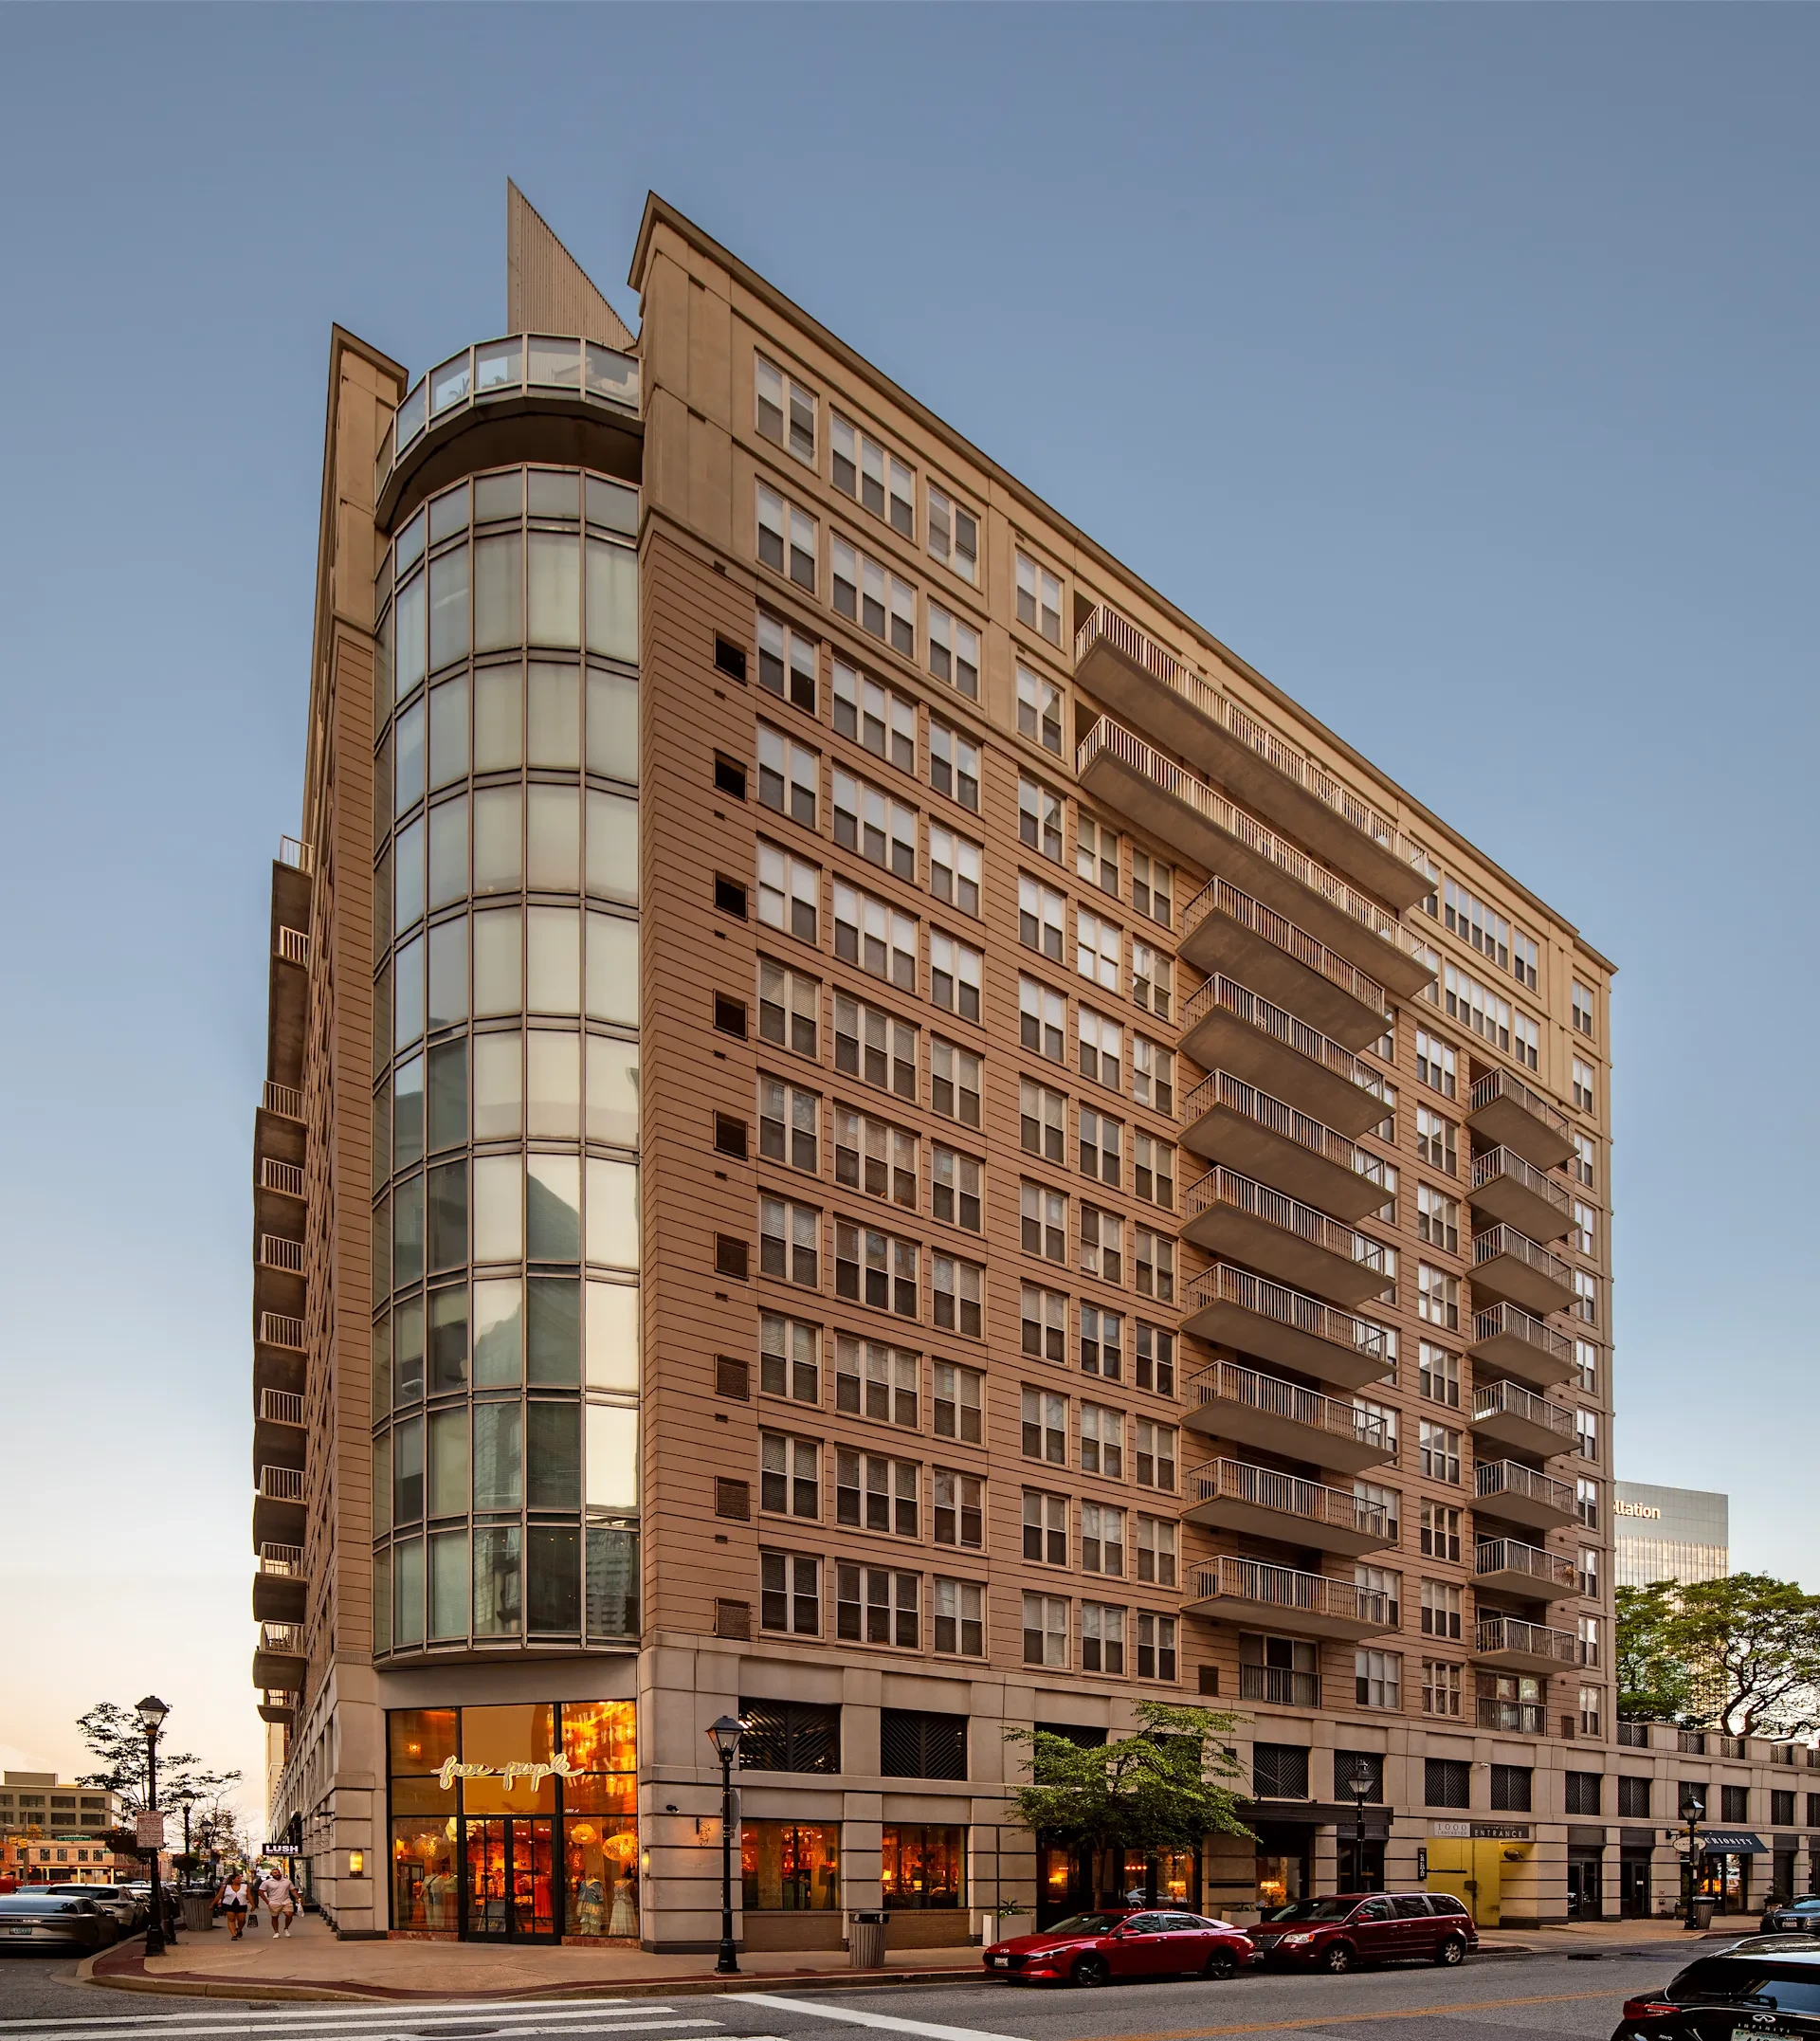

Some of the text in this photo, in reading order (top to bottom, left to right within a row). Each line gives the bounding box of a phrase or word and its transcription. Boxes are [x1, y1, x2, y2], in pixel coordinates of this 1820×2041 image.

[1613, 1499, 1661, 1520] llation
[430, 1753, 585, 1793] free people
[1437, 1823, 1467, 1831] 1000
[1474, 1829, 1522, 1838] ENTRANCE
[1704, 1837, 1753, 1846] URIOSITY
[1738, 2022, 1791, 2033] INFINITI
